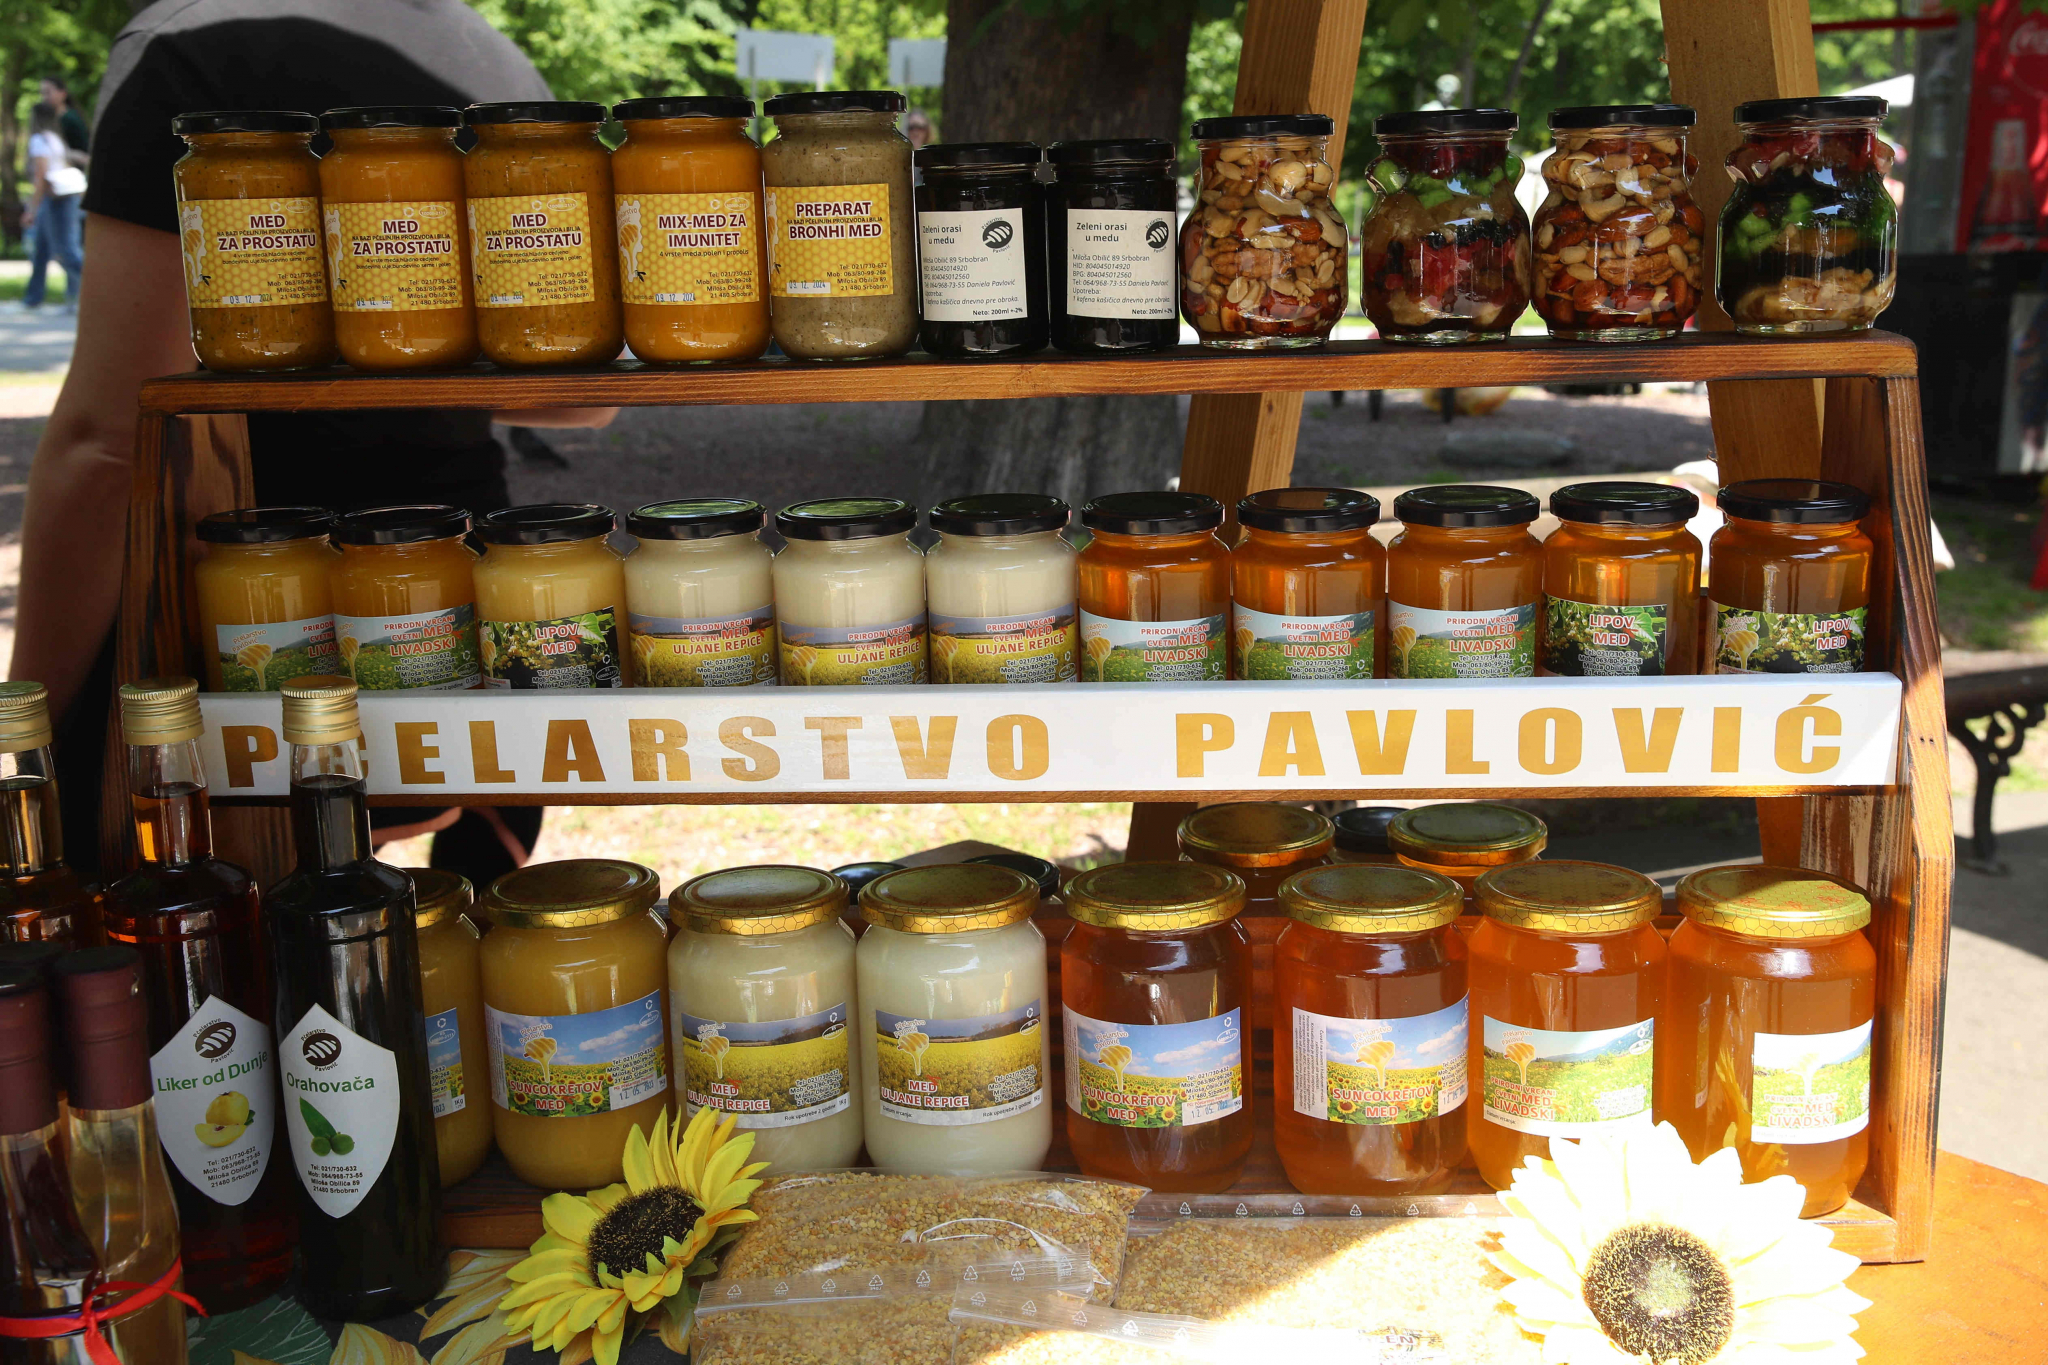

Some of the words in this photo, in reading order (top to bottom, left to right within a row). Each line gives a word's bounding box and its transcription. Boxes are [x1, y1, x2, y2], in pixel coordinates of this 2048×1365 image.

[796, 202, 872, 217] PREPARAT
[250, 215, 286, 228] MED
[383, 221, 418, 234] MED
[512, 214, 547, 228] MED
[659, 215, 727, 229] MIX-MED
[730, 214, 747, 227] ZA
[1076, 222, 1102, 231] Zeleni
[789, 224, 844, 239] BRONHI
[848, 224, 882, 238] MED
[941, 224, 962, 233] orasi
[218, 237, 239, 251] ZA
[242, 234, 316, 250] PROSTATU
[487, 237, 502, 250] ZA
[505, 232, 582, 249] PROSTATU
[668, 233, 740, 247] IMUNITET
[934, 236, 955, 244] medu
[1093, 234, 1119, 242] medu
[353, 242, 372, 255] ZA
[375, 240, 451, 254] PROSTATU
[726, 249, 749, 257] propolis
[813, 280, 826, 289] 2024
[384, 622, 424, 631] PRIRODNI
[426, 615, 455, 626] VRCANI
[683, 622, 723, 632] PRIRODNI
[724, 618, 752, 629] VRCANI
[986, 622, 1026, 632] PRIRODNI
[1028, 616, 1056, 628] VRCANI
[1324, 621, 1354, 629] VRCANI
[1490, 614, 1519, 624] VRCANI
[1590, 614, 1635, 628] LIPOV
[1813, 617, 1852, 633] LIPOV
[391, 632, 421, 641] CVETNI
[423, 623, 453, 638] MED
[536, 623, 578, 639] LIPOV
[690, 634, 719, 643] CVETNI
[722, 627, 749, 640] MED
[848, 631, 887, 640] PRIRODNI
[993, 634, 1023, 642] CVETNI
[1026, 625, 1053, 639] MED
[1183, 624, 1210, 634] VRCANI
[1320, 630, 1350, 641] MED
[1486, 623, 1515, 636] MED
[673, 644, 720, 655] ULJANE
[725, 636, 762, 651] REPICE
[855, 642, 884, 652] CVETNI
[886, 633, 910, 648] MED
[976, 643, 1024, 655] ULJANE
[1029, 634, 1064, 651] REPICE
[1179, 633, 1207, 645] MED
[1450, 638, 1516, 652] LIVADSKI
[1594, 633, 1629, 645] MED
[1817, 636, 1847, 650] MED
[390, 637, 456, 656] LIVADSKI
[542, 641, 576, 655] MED
[838, 650, 885, 664] ULJANE
[889, 642, 920, 658] REPICE
[1284, 644, 1351, 657] LIVADSKI
[1144, 647, 1208, 662] LIVADSKI
[1176, 694, 1842, 777] PAVLOVIĆ
[1354, 1025, 1392, 1040] Pčelarstvo
[157, 1077, 198, 1092] Liker
[202, 1068, 225, 1086] od
[228, 1050, 268, 1080] Dunje
[314, 1062, 338, 1072] Pavlović
[286, 1072, 375, 1093] Orahovača
[510, 1080, 602, 1096] SUNCOKRETOV
[712, 1083, 739, 1096] MED
[909, 1080, 938, 1092] MED
[1490, 1077, 1523, 1092] PRIRODNI
[881, 1087, 922, 1106] ULJANE
[924, 1096, 970, 1107] REPICE
[1082, 1085, 1176, 1107] SUNCOKRETOV
[1333, 1085, 1433, 1101] SUNCOKRETOV
[1495, 1089, 1520, 1101] CVETNI
[1521, 1093, 1552, 1107] MED
[535, 1099, 566, 1111] MED
[687, 1090, 724, 1109] ULJANE
[726, 1099, 770, 1111] REPICE
[1805, 1102, 1833, 1113] MED
[1108, 1107, 1137, 1120] MED
[1366, 1106, 1398, 1117] MED
[1494, 1100, 1555, 1120] LIVADSKI
[1769, 1114, 1835, 1127] LIVADSKI
